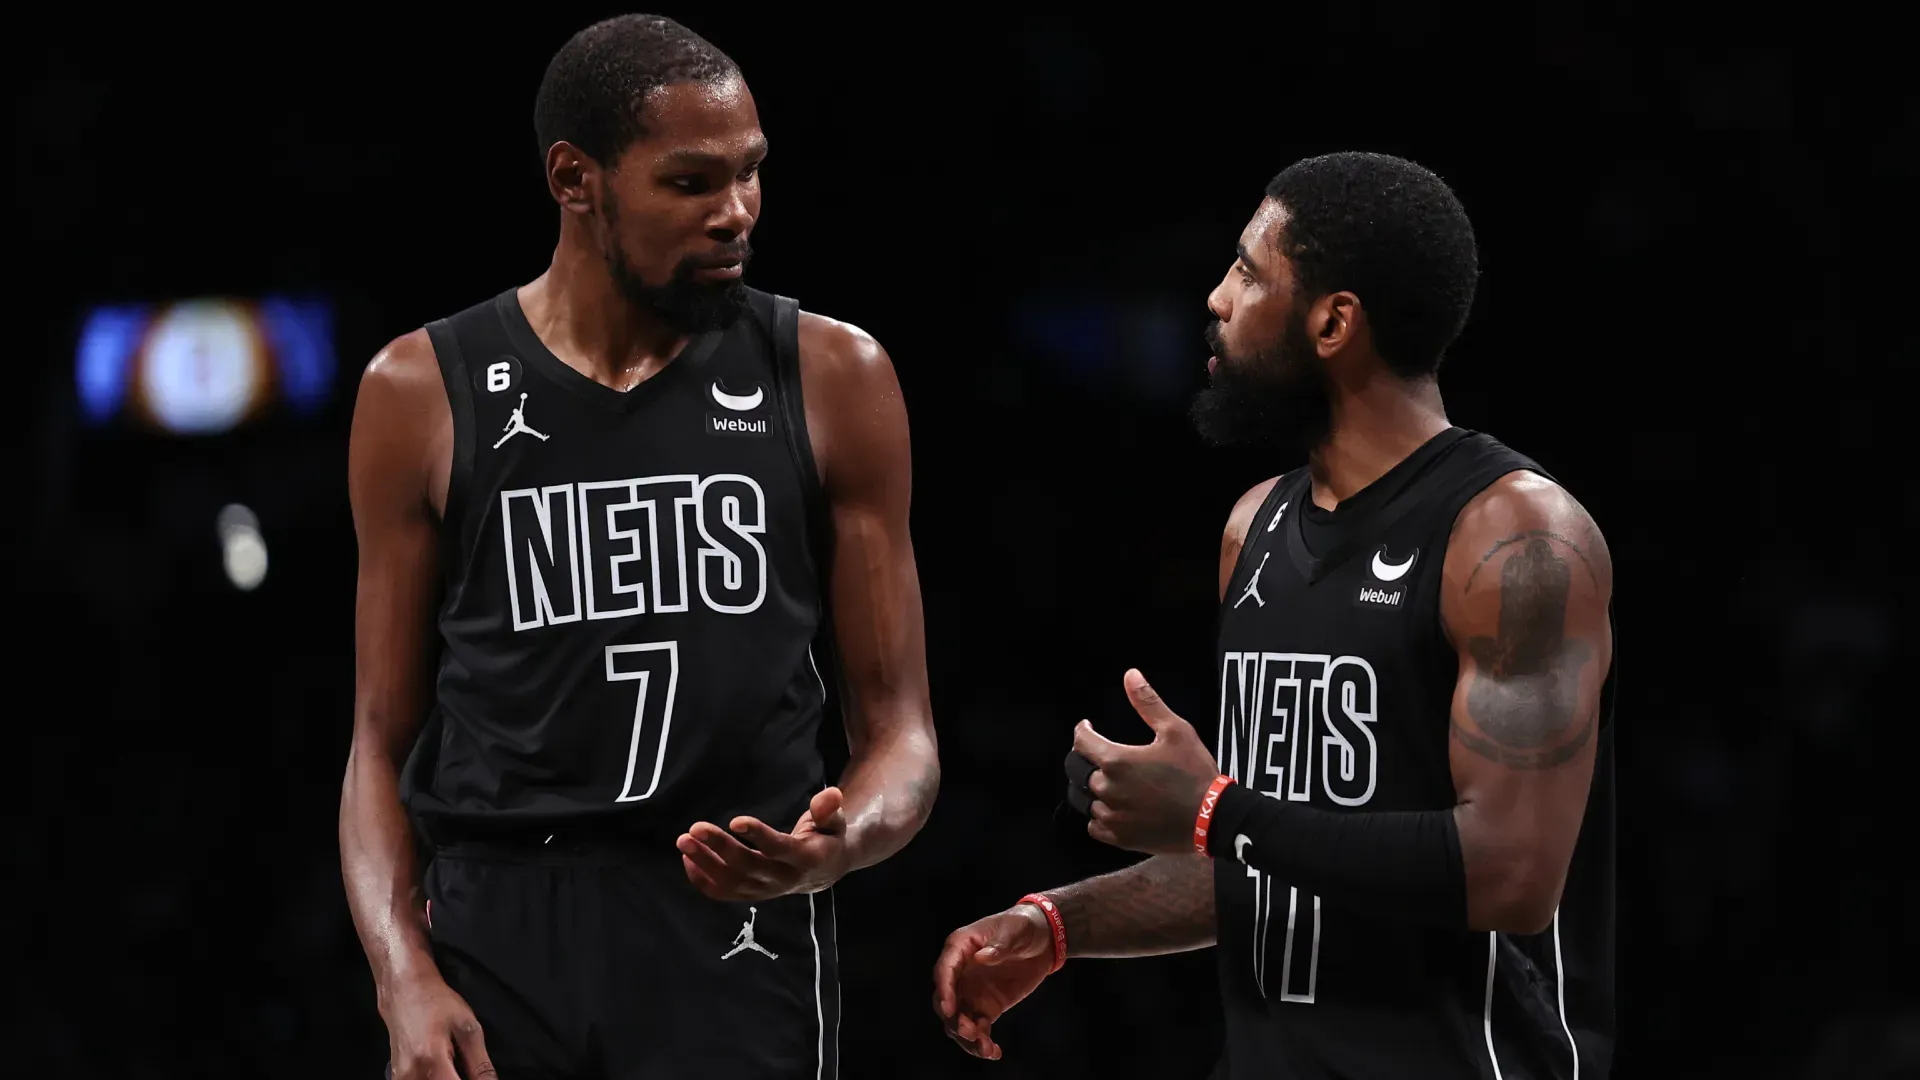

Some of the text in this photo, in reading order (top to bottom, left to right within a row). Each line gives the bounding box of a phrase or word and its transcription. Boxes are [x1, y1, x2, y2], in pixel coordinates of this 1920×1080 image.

[486, 361, 512, 393] 6
[712, 417, 767, 434] Webull
[1267, 501, 1289, 533] 6
[500, 473, 767, 632] NETS
[1359, 587, 1402, 606] Webull
[604, 640, 679, 803] 7
[1217, 651, 1378, 807] NETS
